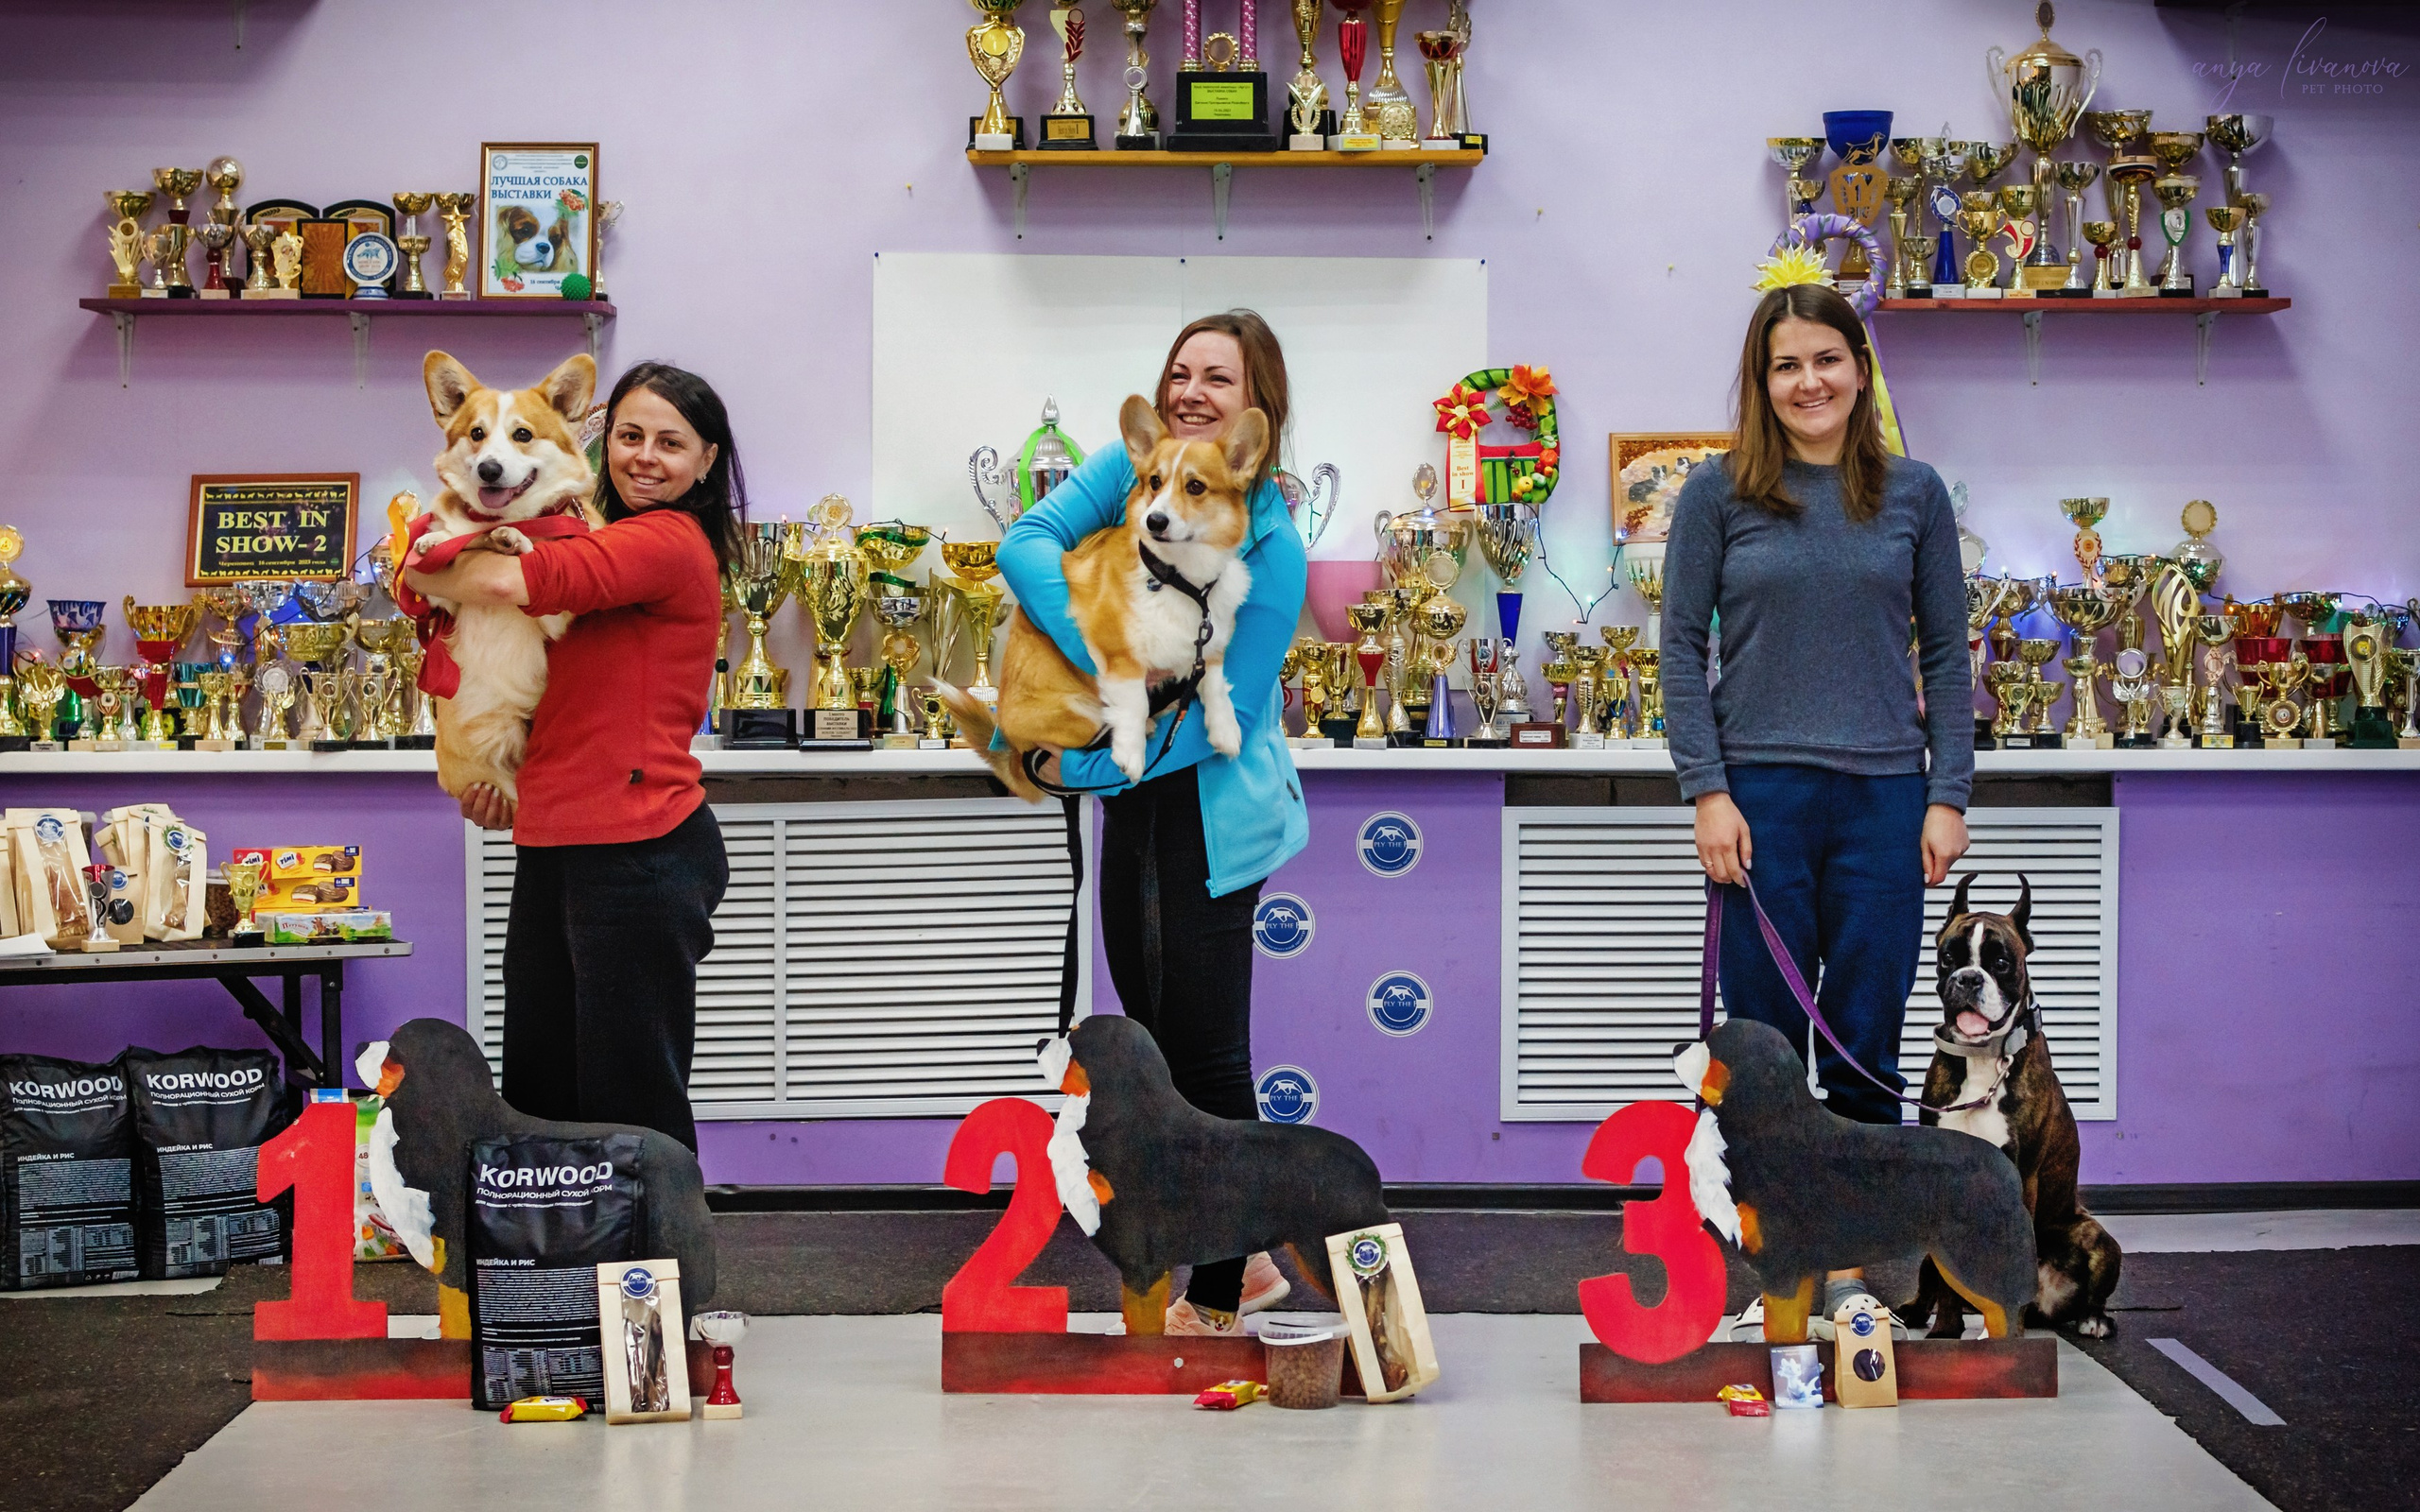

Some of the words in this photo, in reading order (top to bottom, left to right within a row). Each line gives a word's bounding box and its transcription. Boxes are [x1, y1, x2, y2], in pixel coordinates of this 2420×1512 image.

[491, 176, 541, 187] ЛУЧШАЯ
[543, 176, 588, 186] СОБАКА
[492, 190, 552, 199] ВЫСТАВКИ
[216, 511, 288, 529] BEST
[298, 510, 330, 528] IN
[216, 535, 308, 554] SHOW-
[313, 535, 327, 552] 2
[9, 1075, 124, 1099] KORWOOD
[147, 1068, 263, 1090] KORWOOD
[150, 1091, 220, 1099] ПОЛНОРАЦИОННЫЙ
[220, 1089, 245, 1097] СУХОЙ
[245, 1083, 265, 1094] КОРМ
[12, 1097, 83, 1108] ПОЛНОРАЦИОННЫЙ
[83, 1094, 108, 1105] СУХОЙ
[156, 1143, 192, 1153] ИНДЕЙКА
[17, 1153, 52, 1162] ИНДЕЙКА
[479, 1161, 614, 1189] KORWOOD
[476, 1188, 560, 1199] ПОЛНОРАЦИОННЫЙ
[561, 1189, 590, 1197] СУХОЙ
[254, 1102, 389, 1341] 1
[942, 1097, 1069, 1335] 2
[1579, 1100, 1728, 1365] 3
[475, 1258, 510, 1266] ИНДЕЙКА
